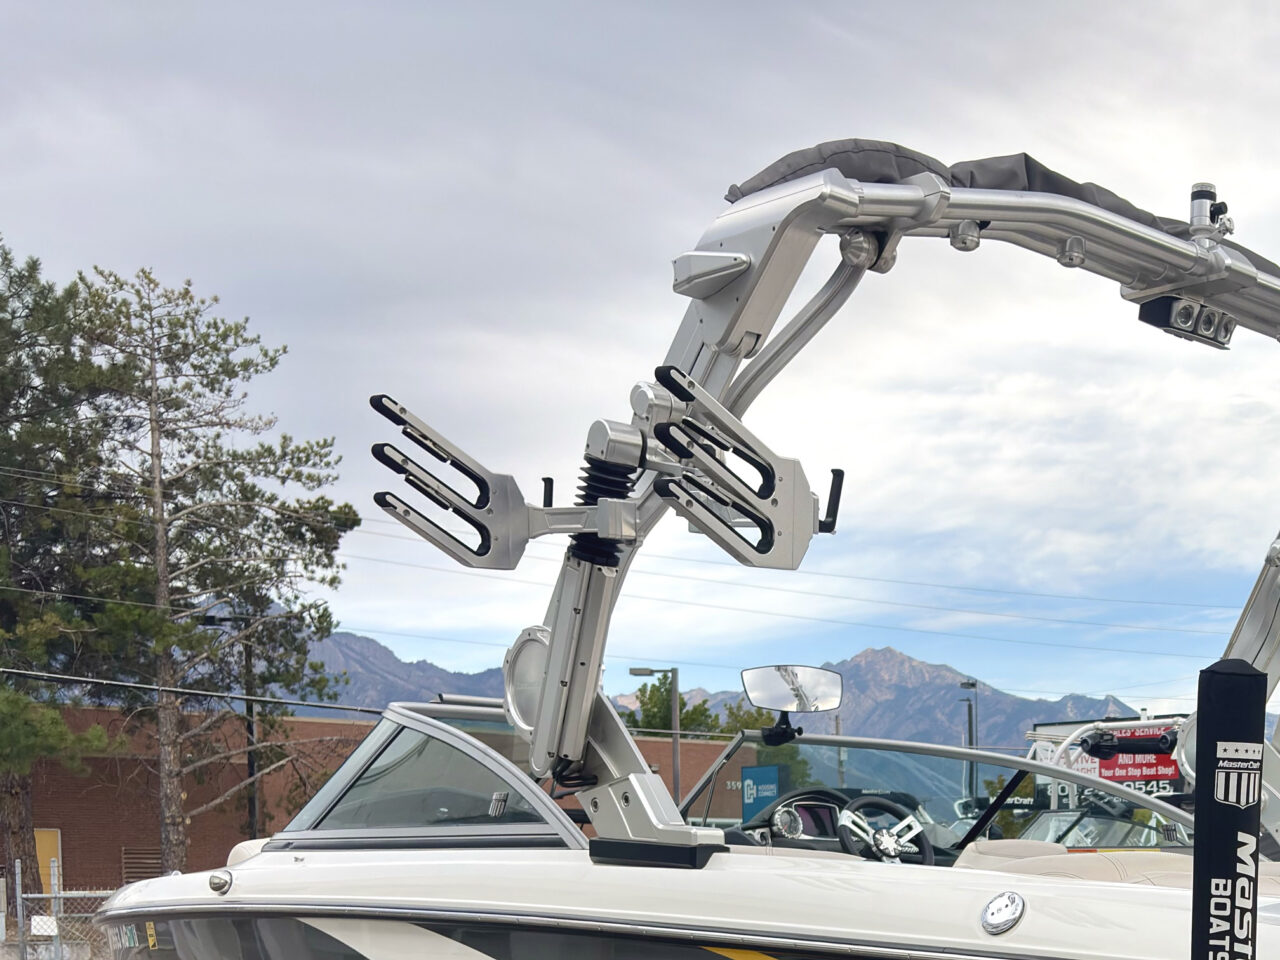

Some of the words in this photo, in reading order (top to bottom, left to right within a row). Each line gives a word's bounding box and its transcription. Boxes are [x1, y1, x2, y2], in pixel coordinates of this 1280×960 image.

[1118, 754, 1133, 764] AND
[1135, 754, 1157, 763] MORE
[1101, 768, 1114, 777] Your
[1115, 767, 1127, 776] One
[1128, 766, 1141, 778] Stop
[1142, 766, 1157, 775] Boat
[1158, 765, 1175, 776] Shop!
[726, 781, 742, 790] 359
